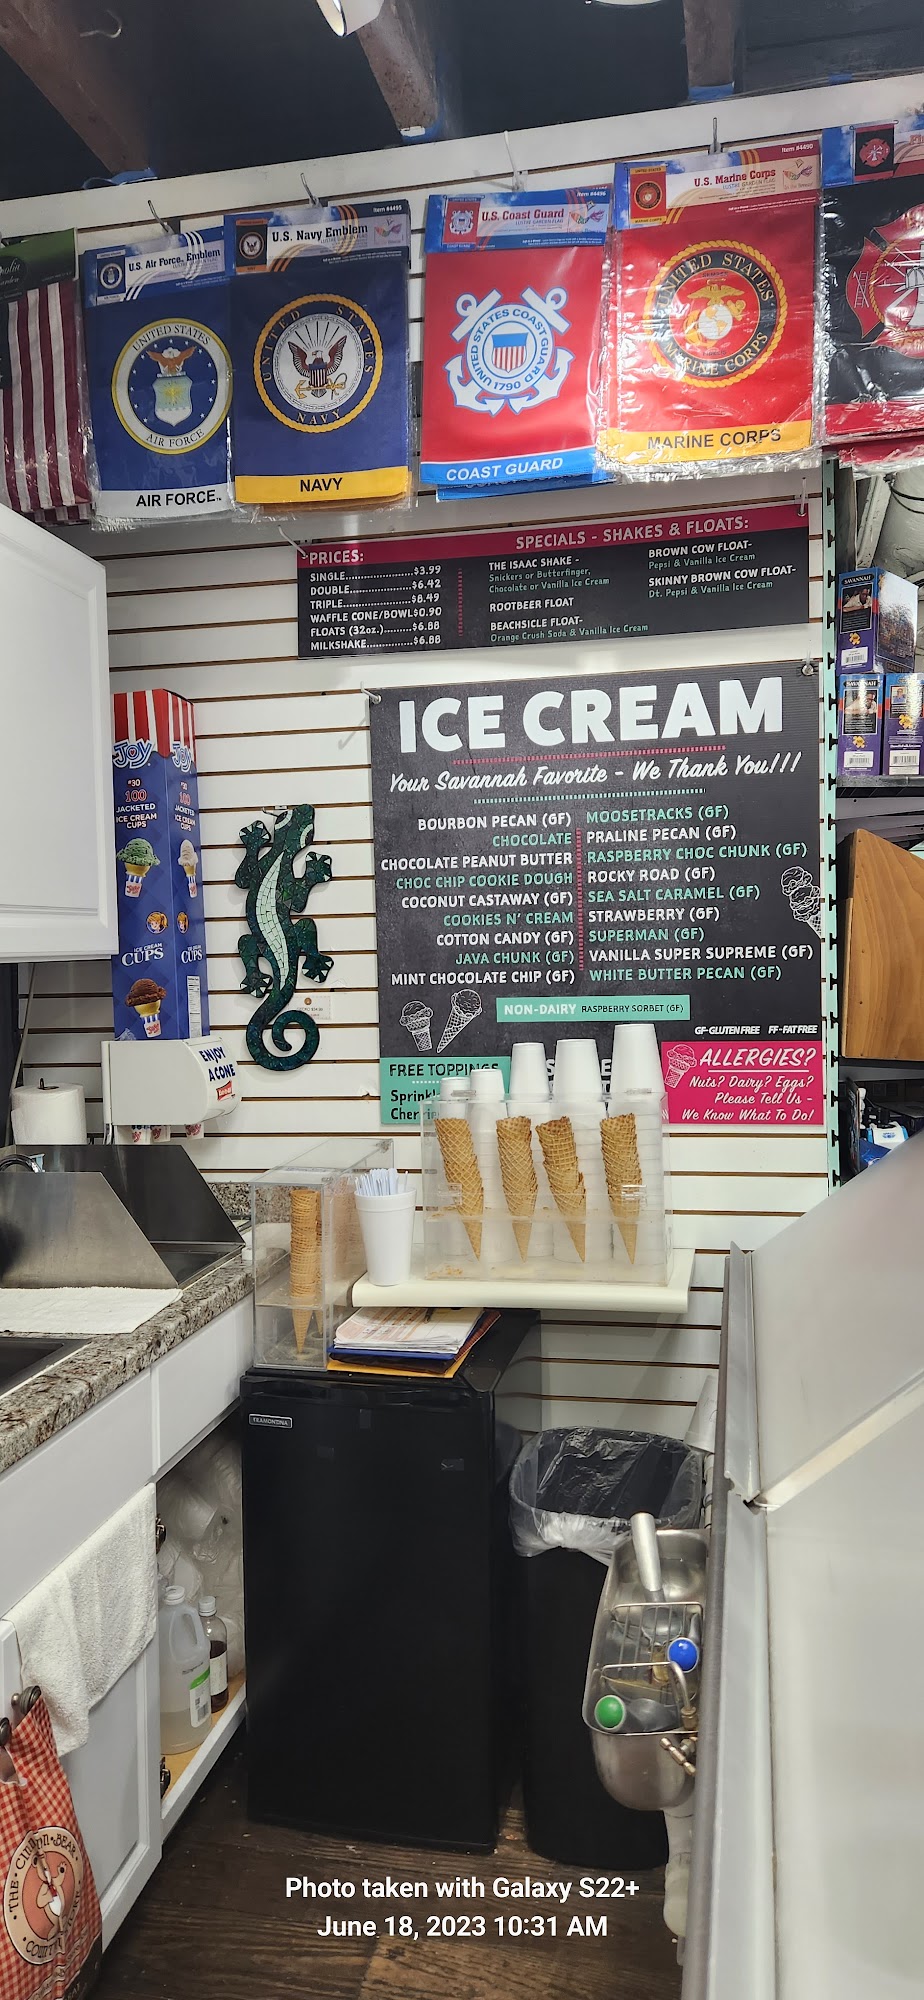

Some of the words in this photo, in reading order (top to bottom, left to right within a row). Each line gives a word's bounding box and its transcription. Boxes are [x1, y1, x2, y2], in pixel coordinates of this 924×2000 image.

[694, 178, 712, 187] U.S.
[715, 173, 746, 184] Marine
[750, 169, 776, 180] Corps
[482, 212, 499, 221] U.S.
[502, 210, 531, 220] Coast
[534, 209, 564, 218] Guard
[272, 231, 292, 242] U.S.
[296, 228, 322, 241] Navy
[325, 224, 368, 238] Emblem
[128, 261, 142, 272] U.S.
[145, 258, 157, 268] Air
[186, 248, 220, 261] Emblem
[658, 254, 712, 307] UNITED
[722, 253, 774, 301] STATES
[474, 309, 510, 342] STATES
[513, 308, 547, 336] COAST
[132, 326, 172, 352] UNITED
[174, 324, 211, 345] STATES
[262, 309, 300, 382] UNITED
[336, 306, 373, 374] STATES
[524, 337, 548, 382] GUARD
[725, 332, 768, 372] CORPS
[471, 345, 492, 386] UNITED
[494, 381, 521, 390] 1790
[296, 409, 342, 424] NAVY
[146, 433, 164, 447] AIR
[168, 428, 204, 447] FORCE
[648, 434, 714, 450] MARINE
[720, 429, 781, 446] CORPS
[446, 465, 501, 481] COAST
[505, 457, 563, 475] GUARD
[300, 478, 342, 492] NAVY
[136, 494, 162, 507] AIR
[516, 531, 586, 549] SPECIALS
[603, 524, 663, 542] SHAKES
[669, 523, 680, 536] &
[686, 516, 749, 534] FLOATS:
[309, 549, 364, 564] PRICES:
[649, 546, 688, 558] BROWN
[692, 544, 715, 554] COW
[718, 540, 752, 552] FLOAT-
[489, 561, 506, 571] THE
[509, 559, 537, 569] ISAAC
[540, 556, 572, 567] SHAKE
[489, 573, 522, 582] Snickers
[537, 568, 591, 578] Butterfinger,
[649, 575, 688, 587] SKINNY
[691, 571, 731, 583] BROWN
[734, 568, 758, 579] COW
[761, 565, 796, 576] FLOAT-
[489, 583, 527, 593] Chocolate
[541, 580, 568, 589] Vanilla
[585, 577, 609, 585] Cream
[490, 600, 541, 612] ROOTBEER
[545, 597, 574, 608] FLOAT
[490, 618, 547, 631] BEACHSICLE
[550, 616, 583, 626] FLOAT-
[491, 633, 519, 642] Orange
[522, 631, 545, 639] Crush
[548, 630, 566, 638] Soda
[579, 627, 607, 635] Vanilla
[623, 623, 648, 632] Cream
[399, 695, 506, 754] ICE
[522, 676, 783, 747] CREAM
[390, 774, 429, 793] Your
[434, 767, 528, 790] Savannah
[534, 764, 608, 786] Favorite
[634, 760, 662, 780] We
[669, 755, 728, 779] Thank
[734, 751, 802, 775] You!!!
[125, 789, 147, 802] 100
[116, 803, 155, 813] JACKETED
[130, 813, 157, 821] CREAM
[587, 806, 693, 824] MOOSETRACKS
[698, 805, 729, 821] (GF)
[418, 817, 487, 831] BOURBON
[492, 814, 537, 828] PECAN
[542, 812, 571, 828] (GF)
[381, 857, 458, 871] CHOCOLATE
[462, 855, 516, 868] PEANUT
[520, 852, 573, 866] BUTTER
[396, 877, 431, 889] CHOC
[435, 875, 465, 888] CHIP
[469, 874, 519, 887] COOKIE
[524, 872, 573, 886] DOUGH
[588, 870, 636, 883] ROCKY
[639, 868, 680, 882] ROAD
[684, 867, 716, 882] (GF)
[443, 914, 501, 927] COOKIES
[506, 913, 520, 925] N'
[526, 911, 573, 924] CREAM
[588, 908, 685, 922] STRAWBERRY
[689, 907, 720, 922] (GF)
[436, 933, 489, 946] COTTON
[494, 932, 541, 945] CANDY
[545, 930, 574, 946] (GF)
[588, 928, 669, 943] SUPERMAN
[674, 927, 705, 943] (GF)
[121, 948, 164, 966] CUPS
[504, 1004, 576, 1016] NON-DAIRY
[581, 1004, 629, 1013] RASPBERRY
[632, 1004, 664, 1012] SORBET
[666, 1003, 684, 1013] (GF)
[199, 1046, 226, 1063] ENJOY
[700, 1047, 817, 1066] ALLERGIES?
[215, 1064, 235, 1079] CONE
[390, 1064, 424, 1076] FREE
[689, 1076, 725, 1088] Nuts?
[729, 1075, 772, 1093] Dairy?
[775, 1076, 814, 1093] Eggs?
[715, 1093, 755, 1104] Please
[760, 1092, 783, 1104] Tell
[786, 1093, 801, 1104] Us
[682, 1109, 699, 1120] We
[703, 1109, 734, 1120] Know
[739, 1109, 771, 1120] What
[775, 1109, 787, 1120] To
[792, 1109, 814, 1121] Do!
[9, 1880, 19, 1912] THE
[53, 1834, 76, 1858] BEAR
